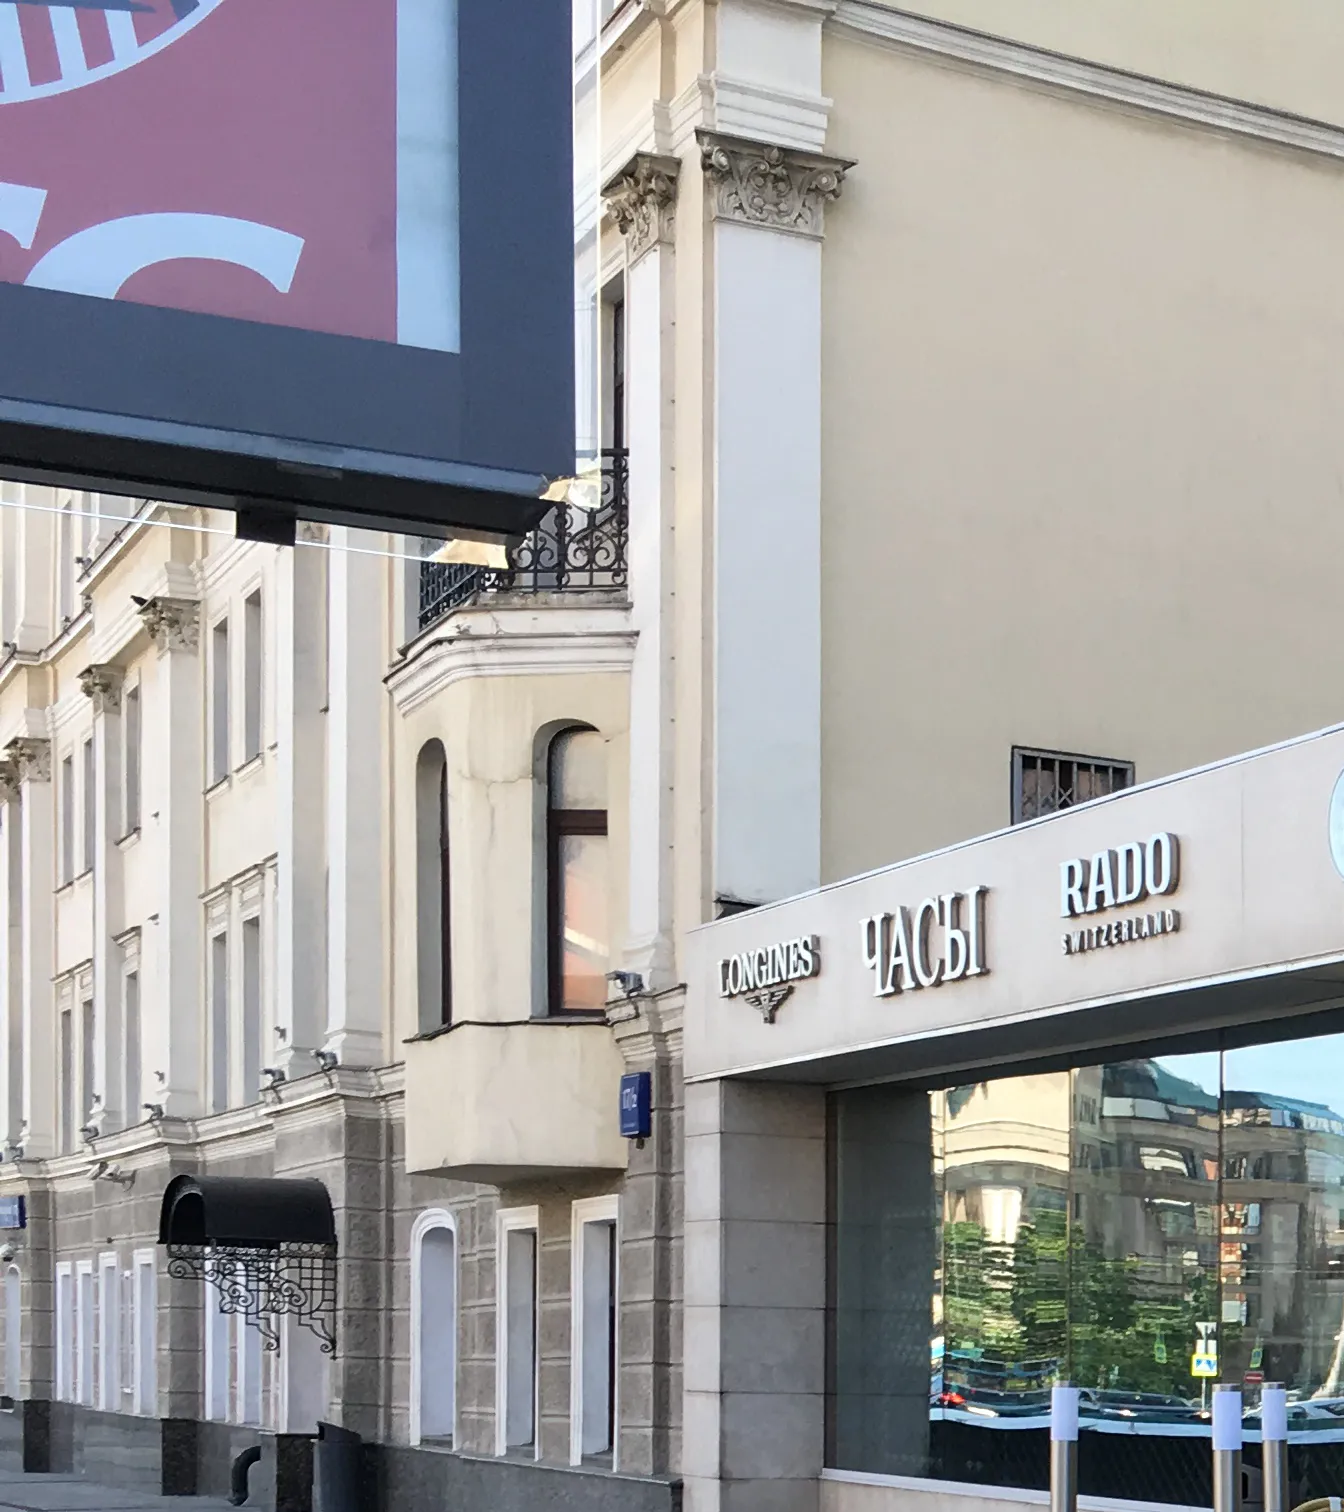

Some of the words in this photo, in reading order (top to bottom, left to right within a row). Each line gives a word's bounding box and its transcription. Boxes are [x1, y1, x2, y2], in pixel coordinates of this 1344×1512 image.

[1059, 831, 1181, 919] RADO
[716, 934, 820, 998] LONGINES
[859, 885, 990, 998] ЧАСЫ
[1061, 908, 1181, 956] SWITZERLAND
